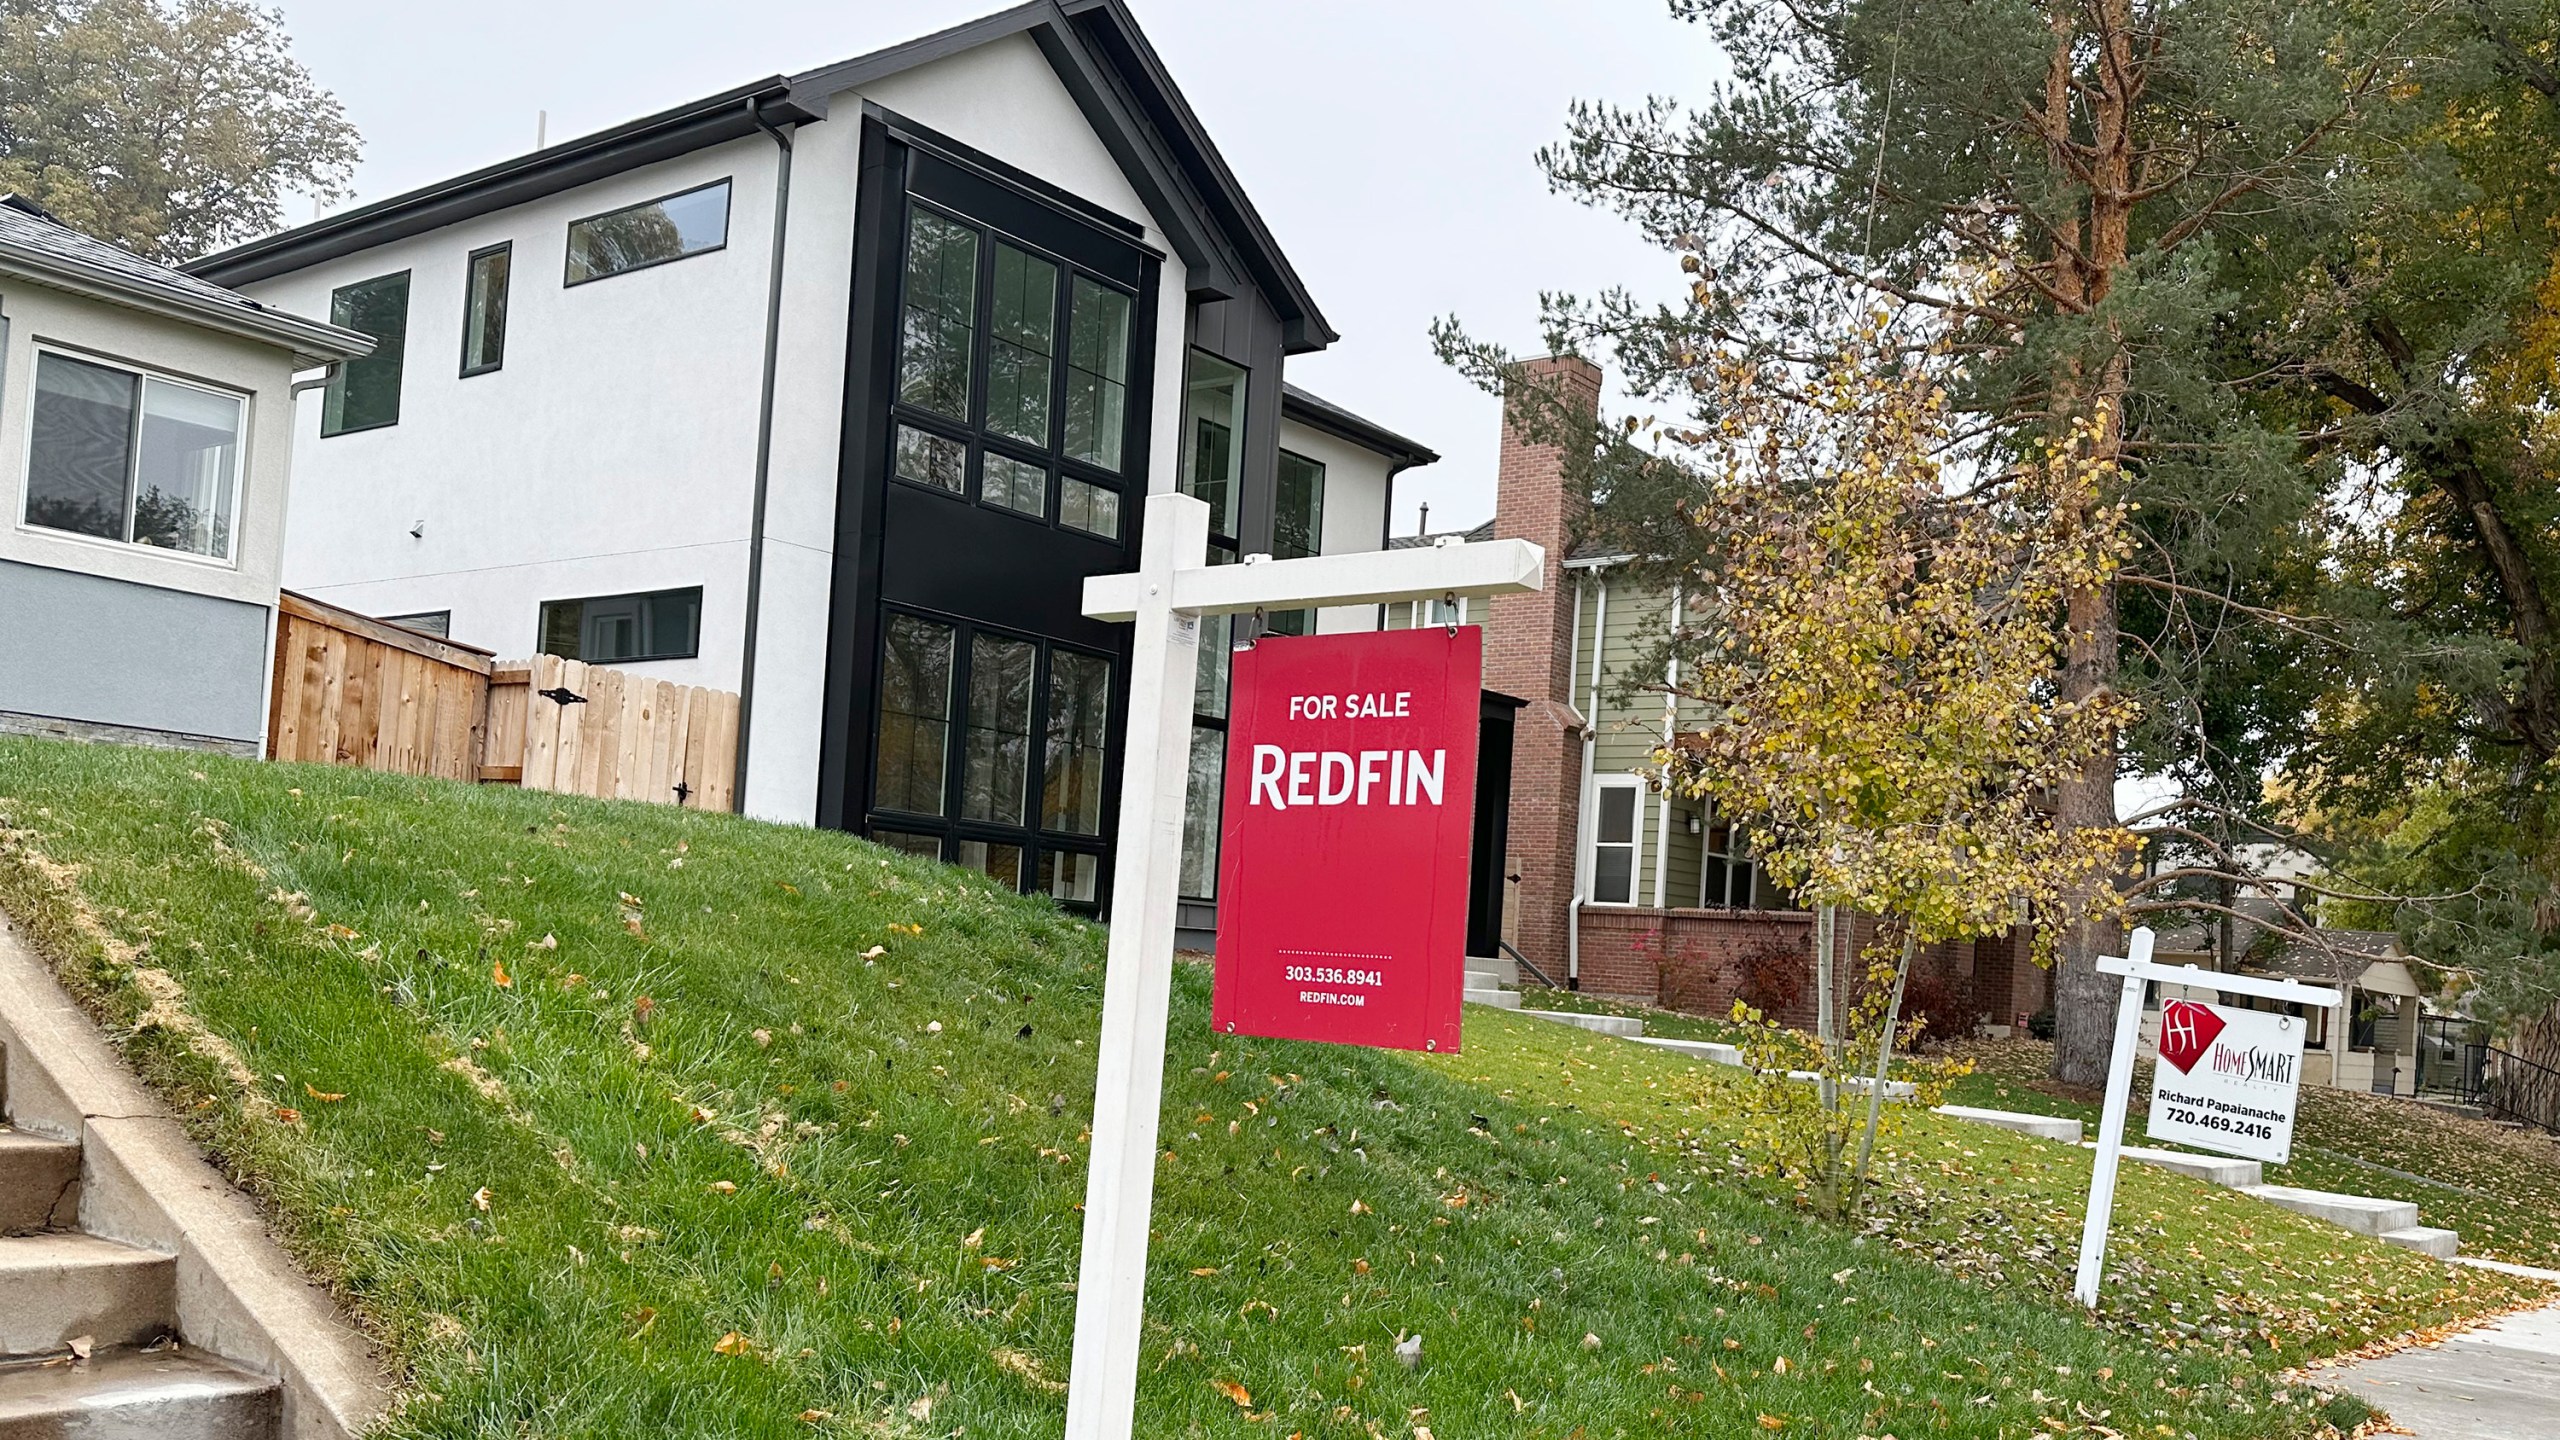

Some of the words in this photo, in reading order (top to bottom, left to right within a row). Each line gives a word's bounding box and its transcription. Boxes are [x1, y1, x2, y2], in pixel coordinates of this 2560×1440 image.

[1290, 696, 1337, 720] FOR
[1345, 692, 1411, 718] SALE
[1250, 744, 1446, 811] REDFIN
[1285, 966, 1382, 986] 303.536.8941
[1300, 991, 1364, 1006] REDFIN.COM
[2158, 1089, 2204, 1107] Richard
[2207, 1098, 2286, 1123] Papaianache
[2166, 1107, 2272, 1139] 720.469.2416
